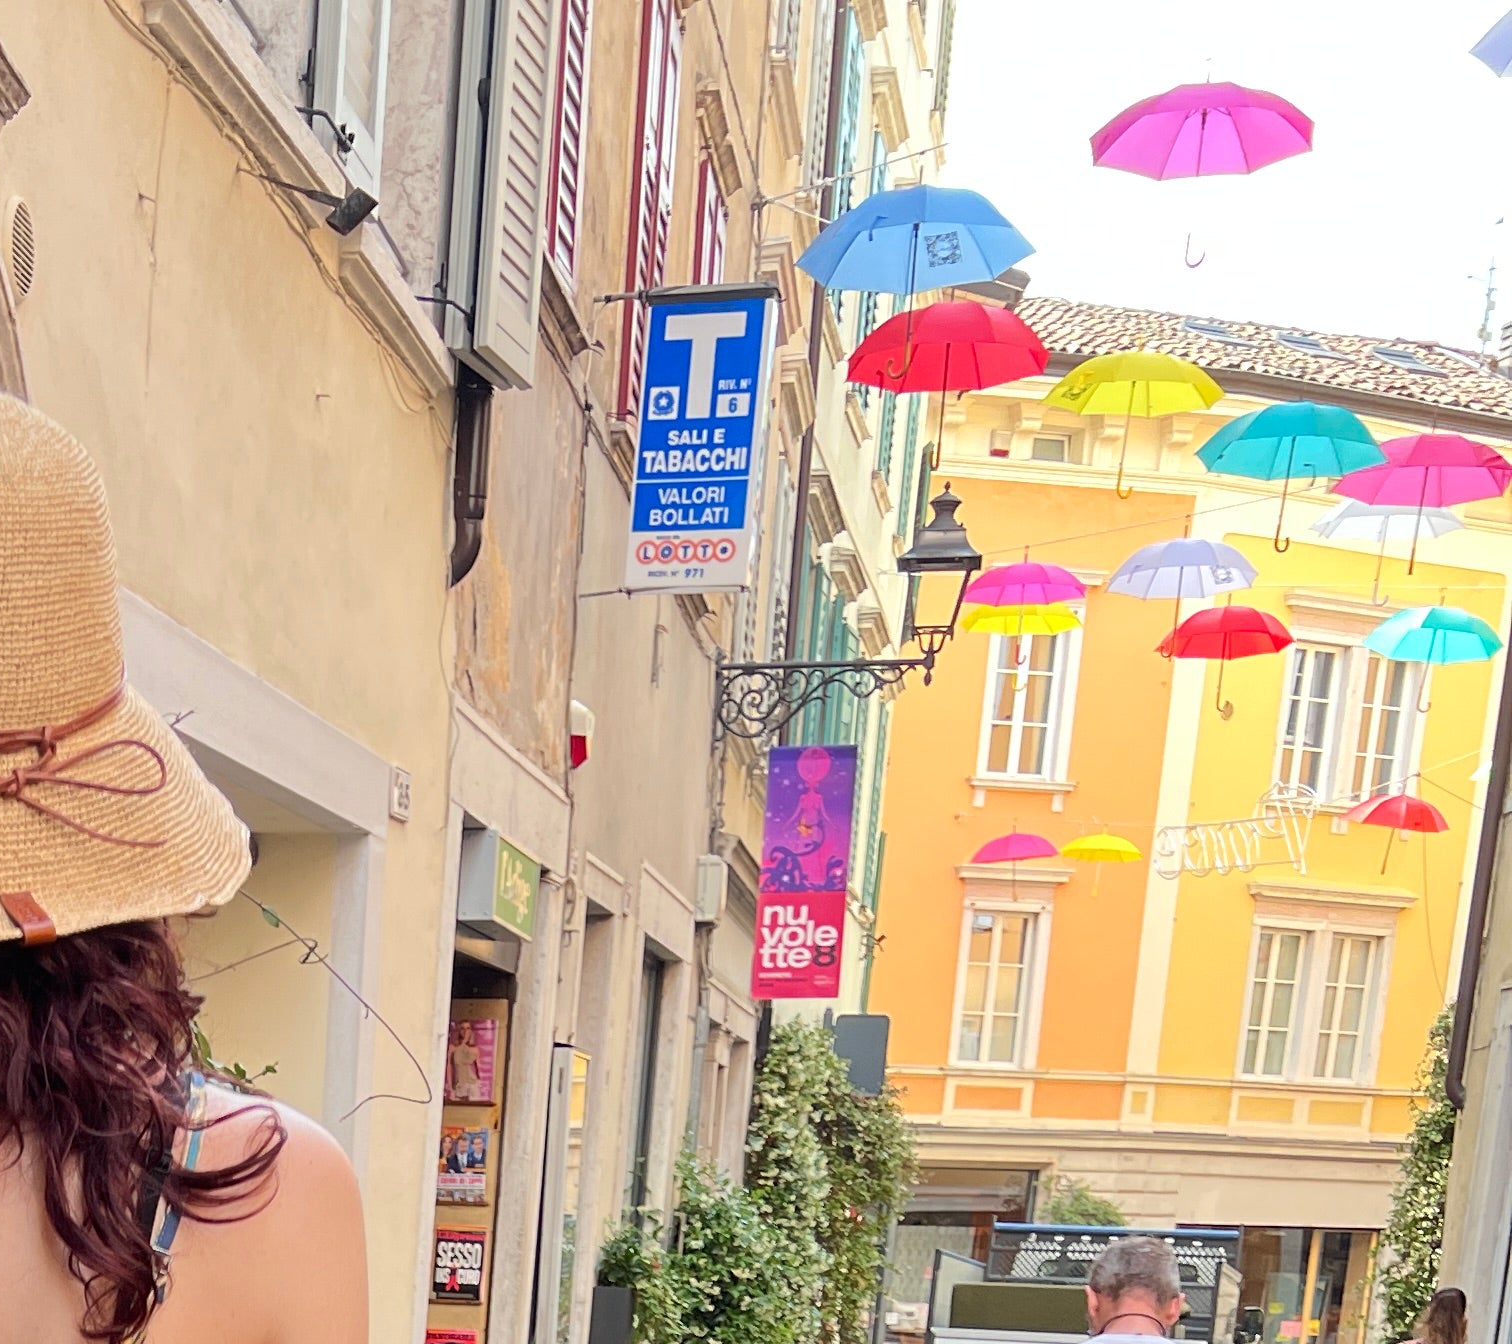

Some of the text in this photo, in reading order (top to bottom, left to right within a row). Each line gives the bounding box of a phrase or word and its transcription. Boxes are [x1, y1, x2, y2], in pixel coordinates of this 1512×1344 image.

[664, 311, 748, 419] T
[728, 397, 738, 413] 6
[667, 428, 726, 446] SALI E
[642, 447, 748, 473] TABACCHI
[658, 486, 726, 505] VALORI
[648, 507, 730, 526] BOLLATI
[639, 540, 735, 563] LOTTO
[684, 568, 705, 578] 971
[762, 905, 809, 926] nu
[760, 920, 838, 947] vole
[436, 1241, 483, 1269] SESSO
